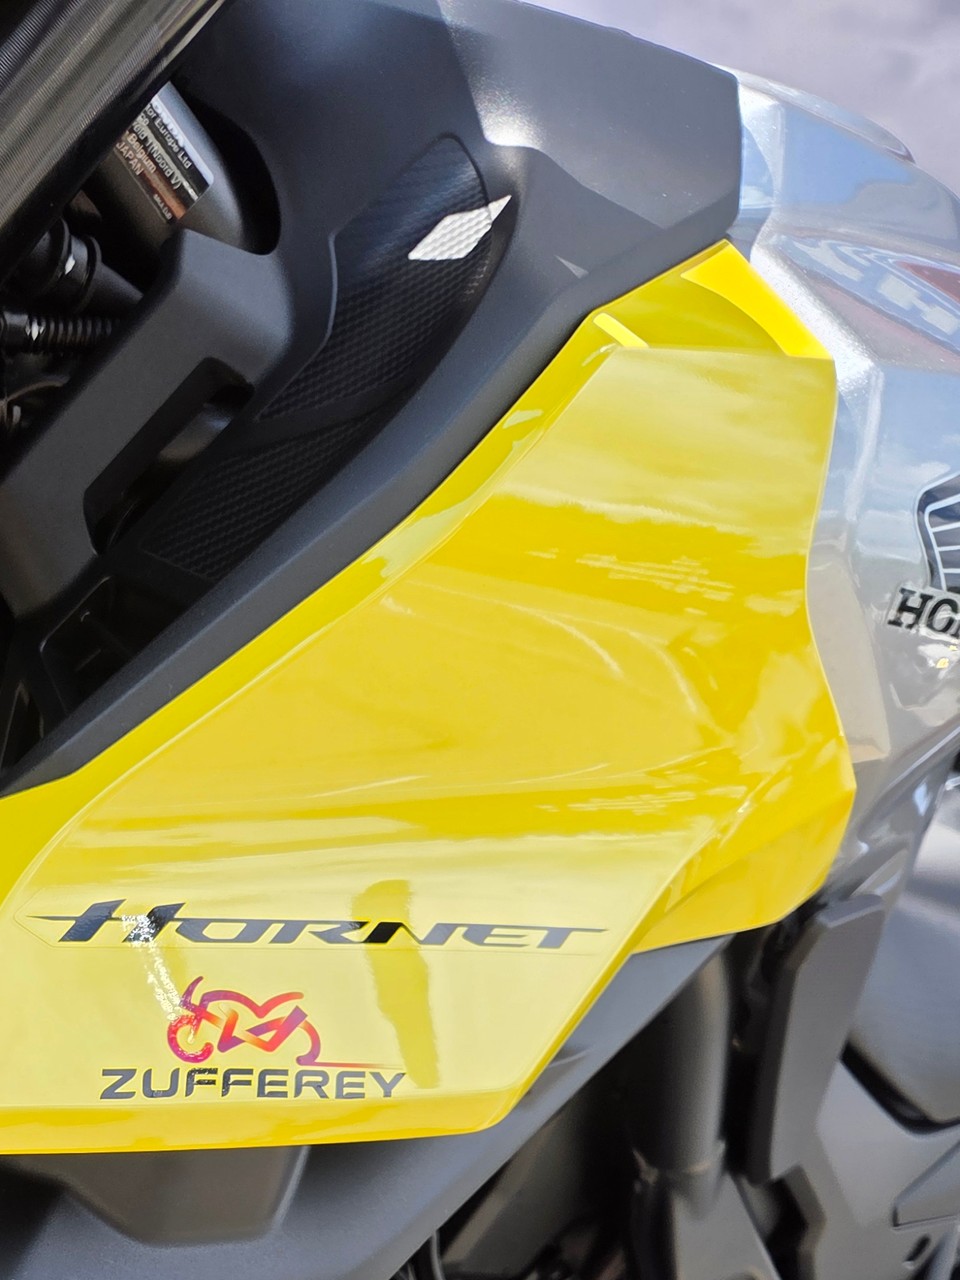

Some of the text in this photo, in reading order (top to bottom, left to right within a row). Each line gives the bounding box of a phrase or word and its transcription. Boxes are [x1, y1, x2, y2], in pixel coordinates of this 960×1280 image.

[115, 141, 144, 176] JAPAN
[127, 133, 157, 173] Belgium
[154, 117, 181, 152] Europe
[177, 150, 192, 168] Ltd
[887, 586, 960, 640] HO
[100, 1068, 407, 1100] ZUFFEREY
